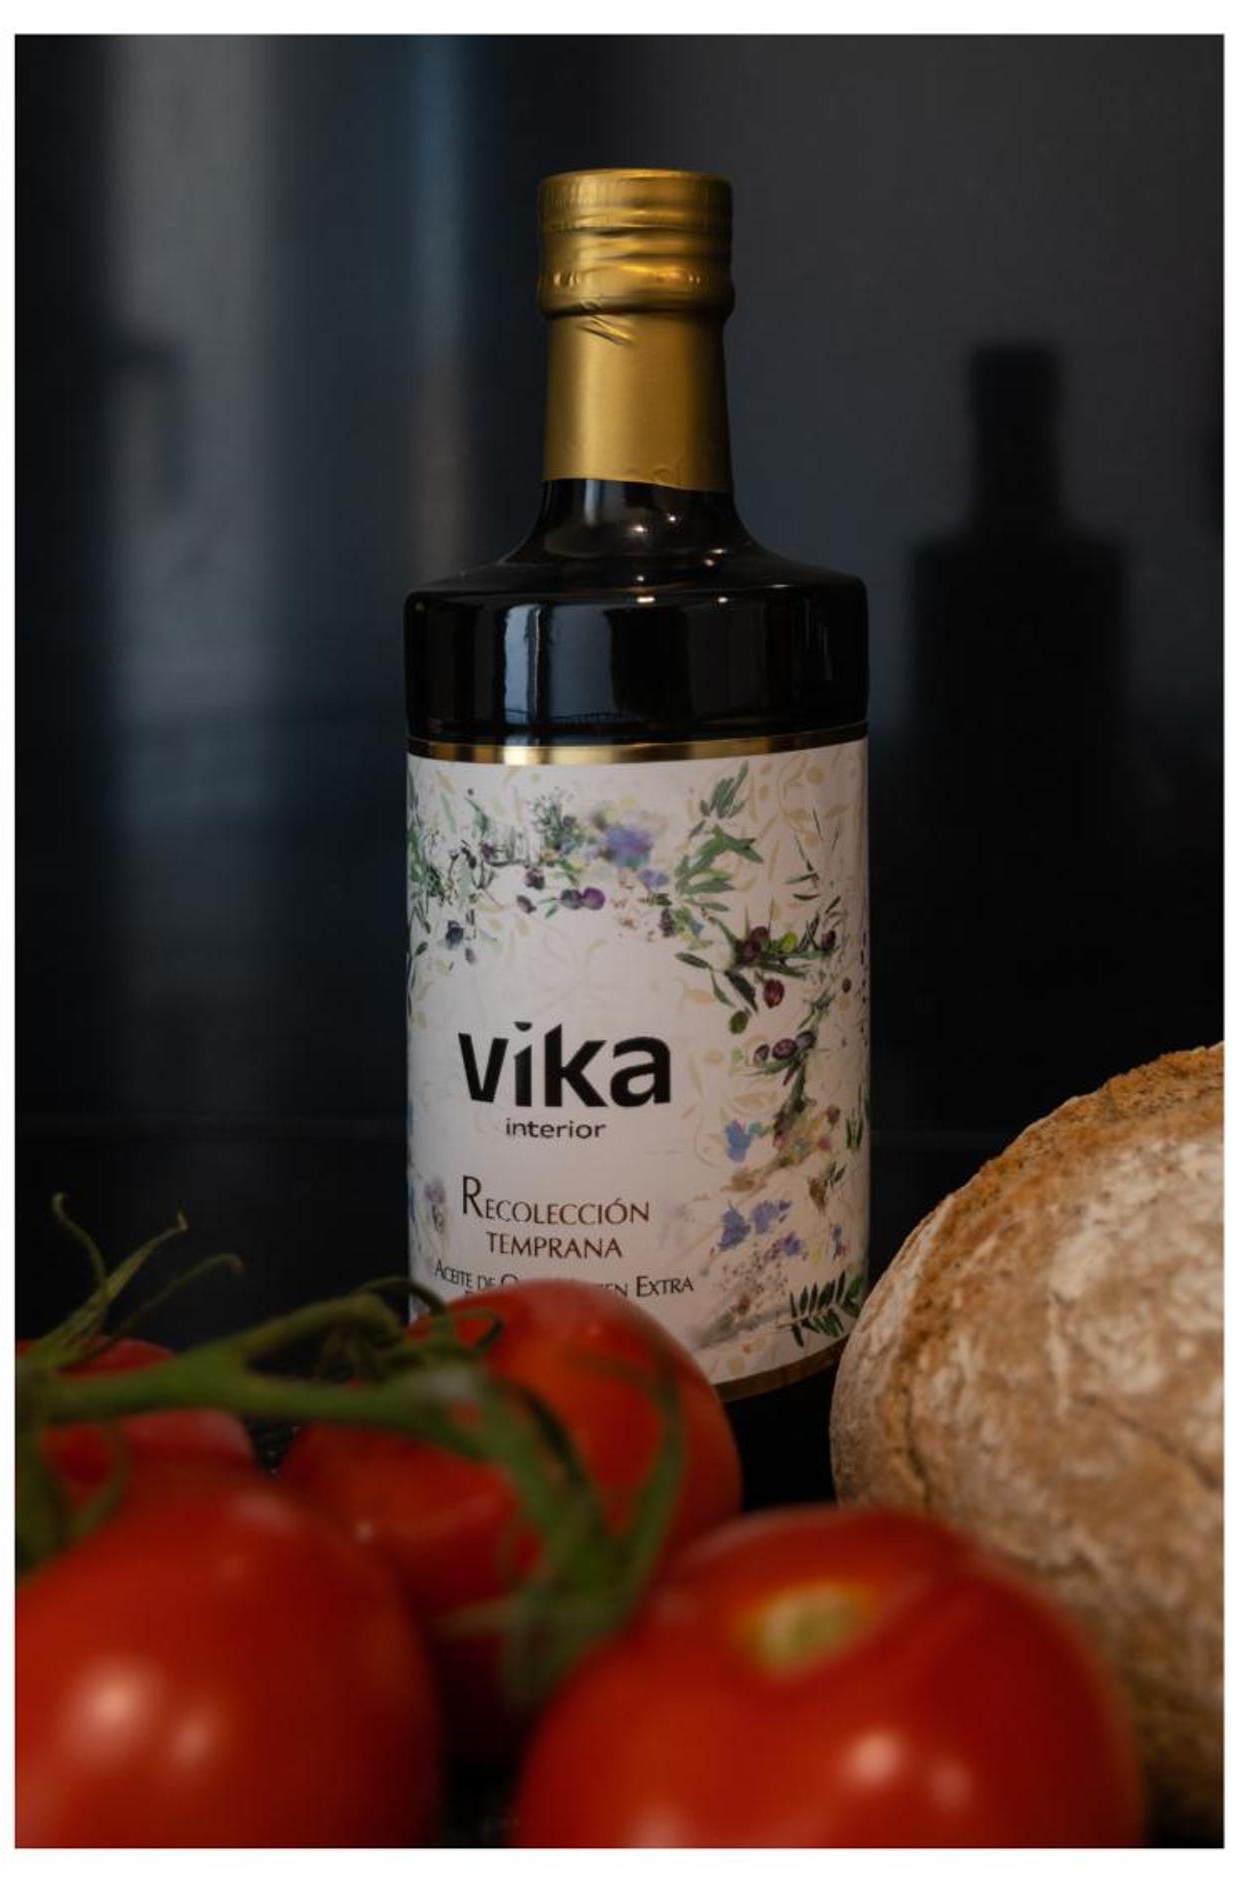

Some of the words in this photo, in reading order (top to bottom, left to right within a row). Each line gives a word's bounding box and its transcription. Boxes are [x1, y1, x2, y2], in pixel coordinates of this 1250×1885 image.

[458, 1021, 671, 1107] vika
[505, 1118, 606, 1139] interior
[486, 1232, 623, 1259] TEMPRANA
